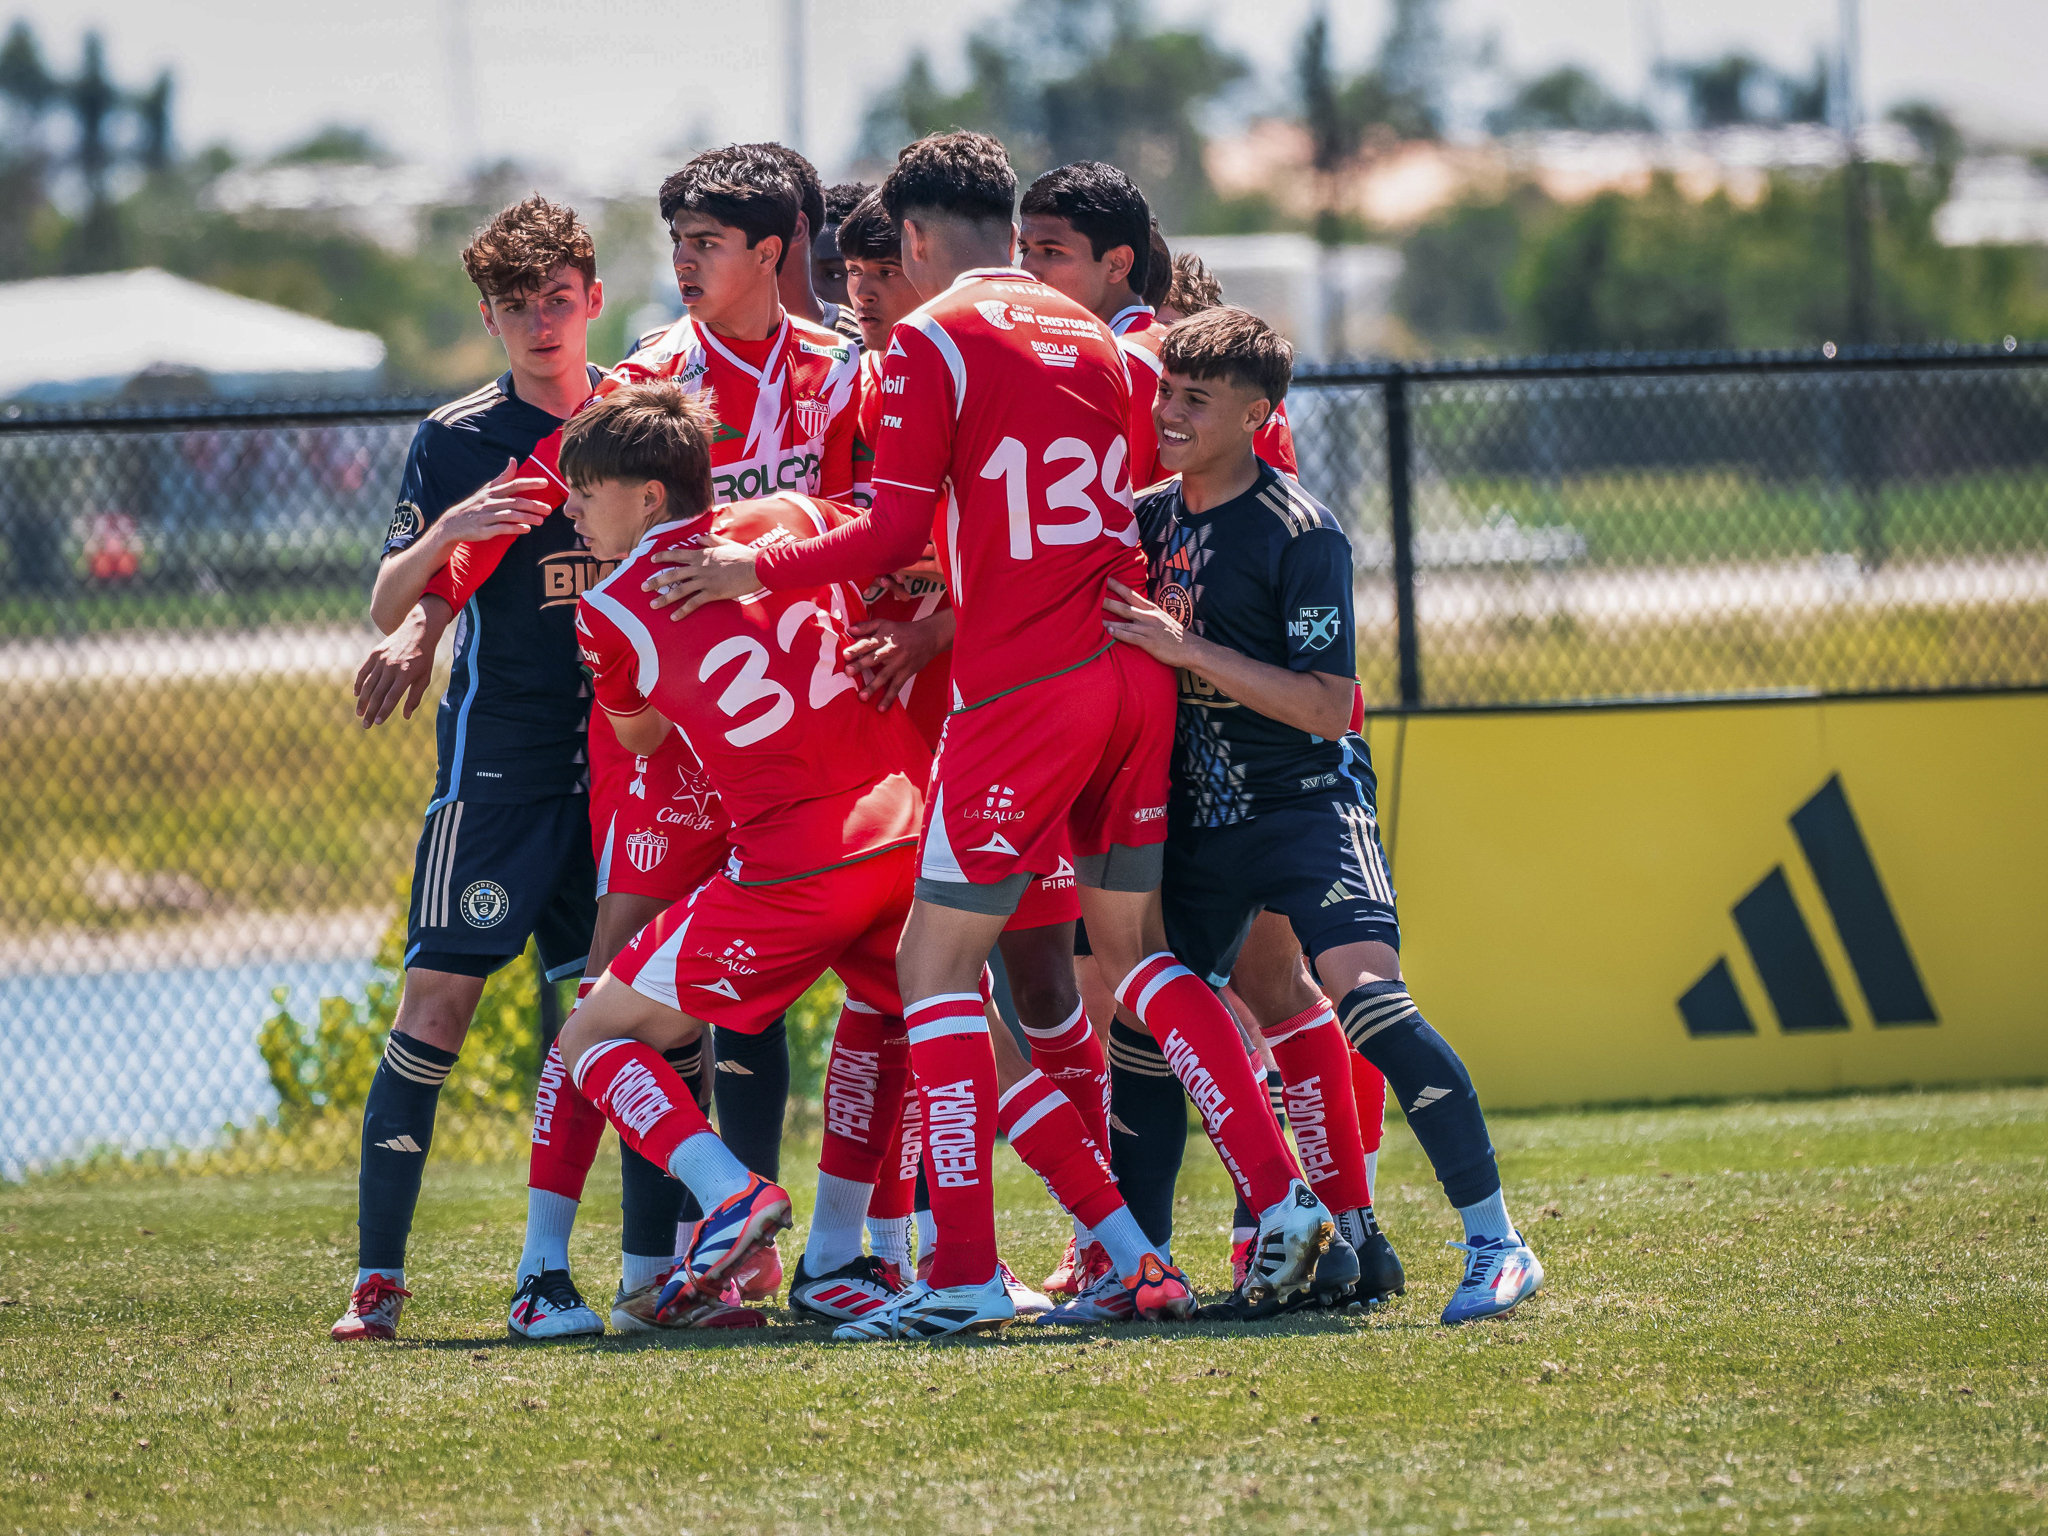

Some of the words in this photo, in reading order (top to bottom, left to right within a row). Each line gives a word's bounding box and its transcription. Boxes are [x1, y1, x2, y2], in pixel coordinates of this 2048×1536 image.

[991, 283, 1057, 298] PIRMA
[1011, 303, 1035, 314] GRUPO
[1009, 310, 1035, 324] SAN
[1035, 315, 1101, 335] CRISTOBAL
[1048, 328, 1062, 336] casa
[1030, 340, 1079, 357] SISOLAR
[979, 434, 1140, 560] 139
[545, 562, 621, 597] BIM
[1158, 586, 1190, 610] PHILADELPHIA
[1302, 609, 1319, 618] MLS
[698, 600, 859, 748] 32
[656, 806, 696, 826] Carl's
[693, 815, 715, 831] Jr.
[963, 808, 980, 819] LA
[982, 809, 1025, 824] SALUD
[629, 834, 665, 846] NECAXA
[463, 882, 507, 904] PHILADELPHIA
[1042, 878, 1077, 891] PIRM
[696, 946, 713, 959] LA
[1163, 1027, 1234, 1132] PERDURA
[605, 1058, 676, 1139] PERDURA
[827, 1046, 879, 1144] PERDURA
[927, 1079, 980, 1188] PERDURA
[1285, 1075, 1339, 1185] PERDURA
